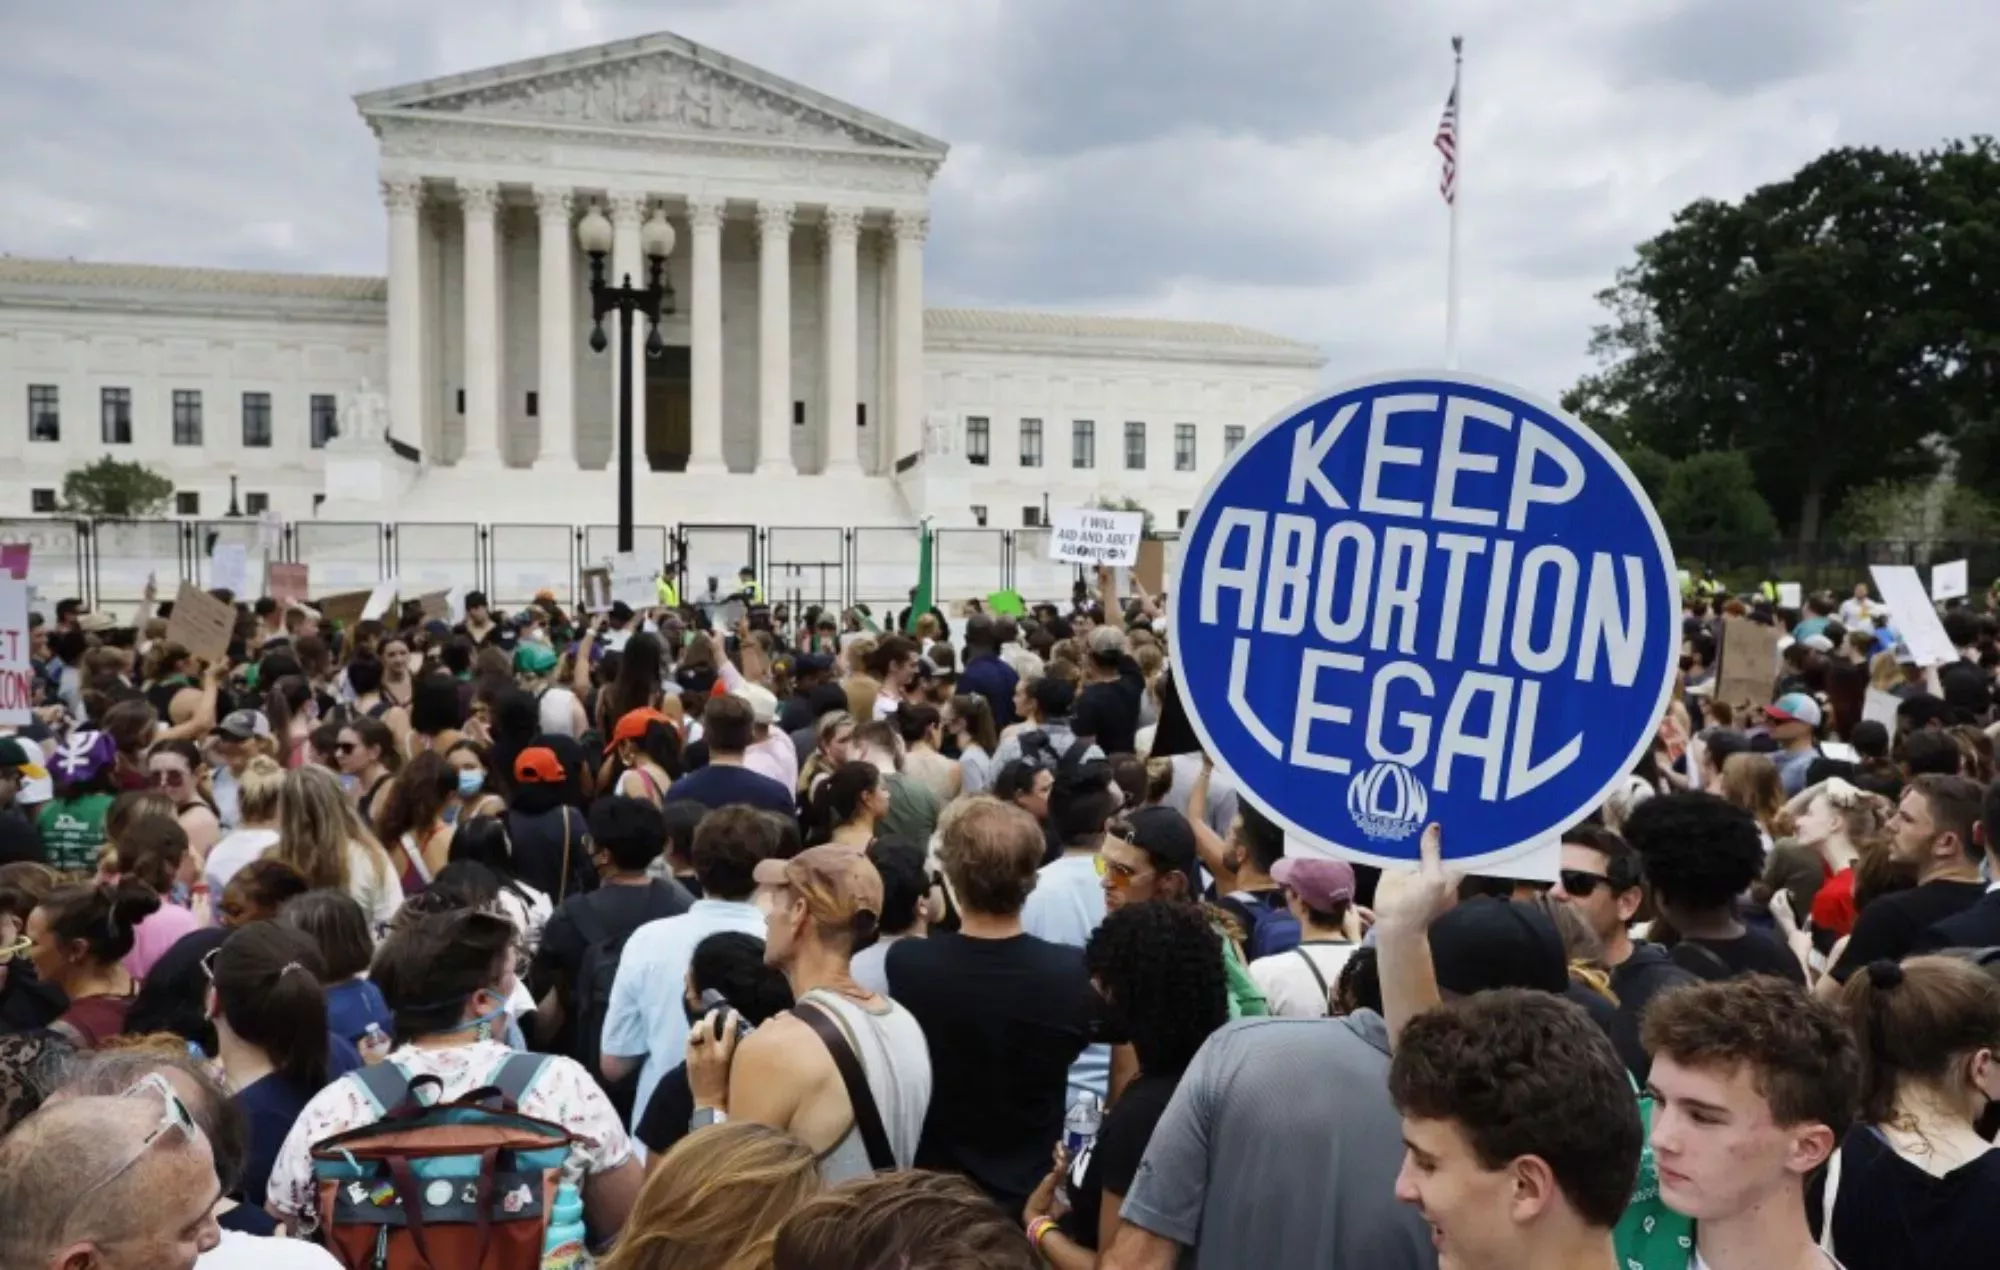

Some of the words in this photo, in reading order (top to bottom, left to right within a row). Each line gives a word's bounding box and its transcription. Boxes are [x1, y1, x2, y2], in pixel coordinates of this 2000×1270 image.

[1089, 516, 1116, 530] WILL
[1287, 395, 1585, 531] KEEP
[1057, 528, 1078, 541] AID
[1080, 531, 1104, 544] AND
[1106, 533, 1137, 546] ABET
[1200, 507, 1646, 687] ABORTION
[1228, 637, 1583, 801] LEGAL
